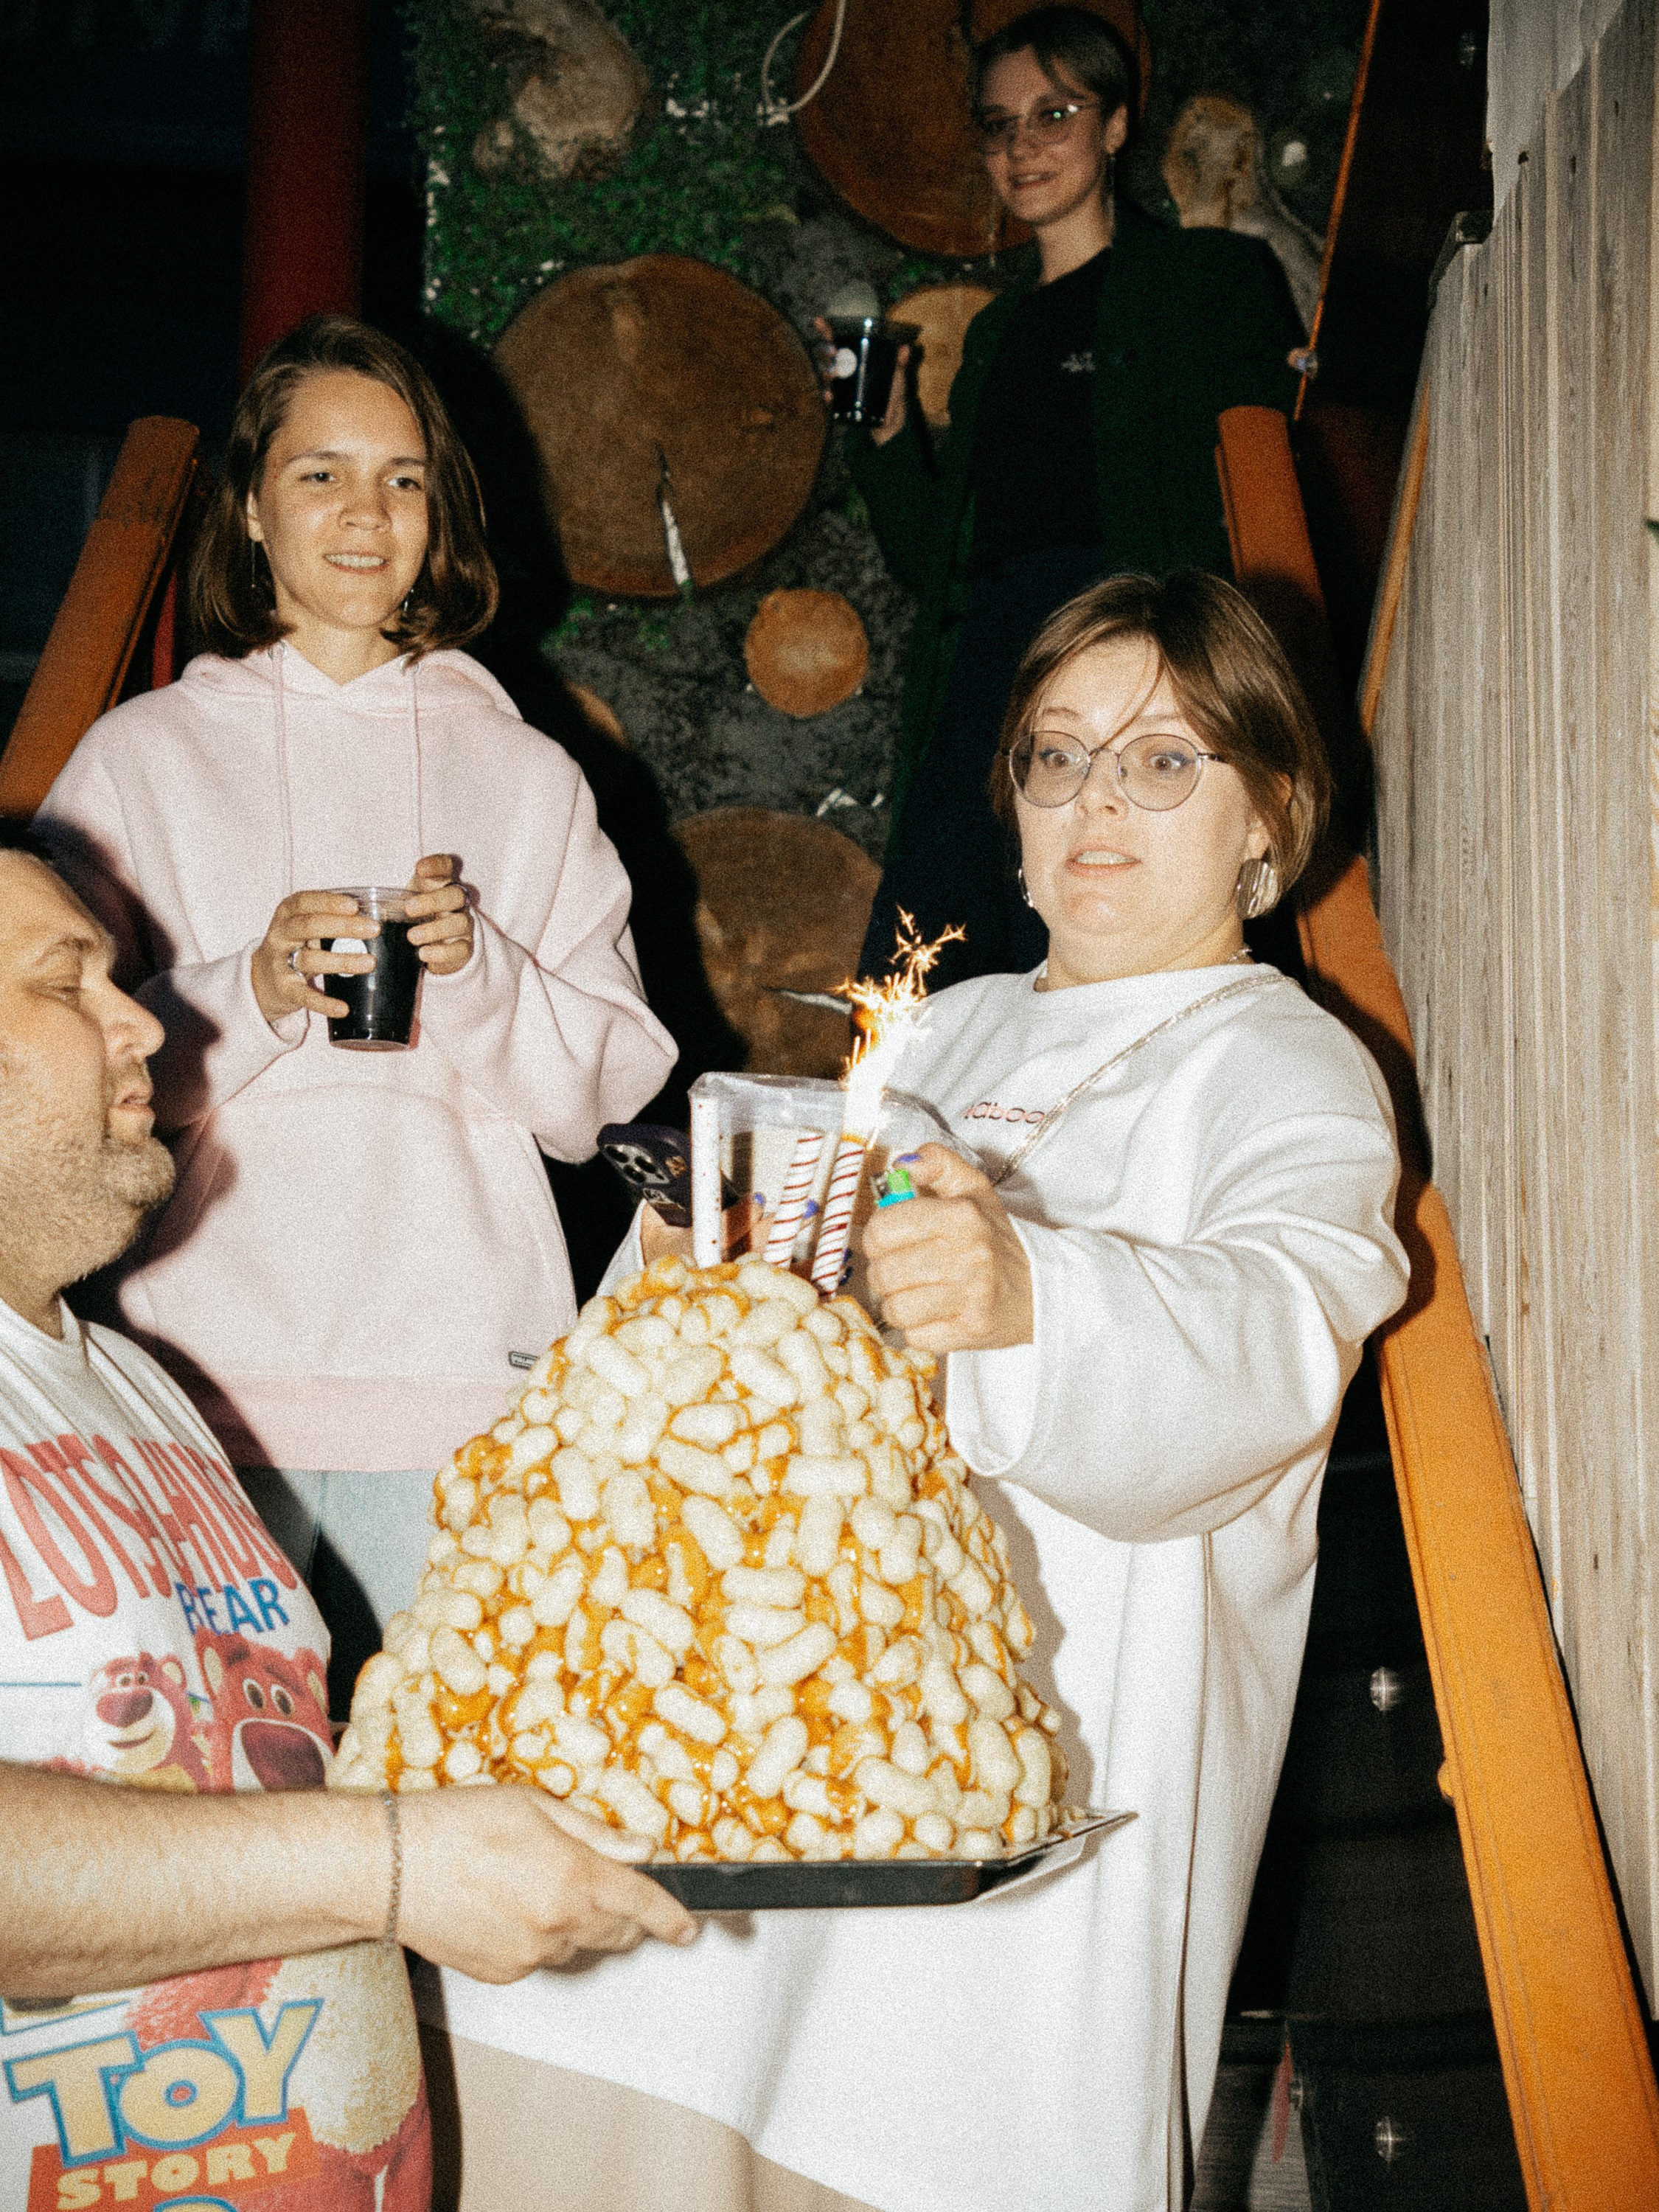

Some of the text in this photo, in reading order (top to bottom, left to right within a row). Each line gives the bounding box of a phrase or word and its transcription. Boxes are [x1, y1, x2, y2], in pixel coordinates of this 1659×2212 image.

[174, 1579, 290, 1635] BEAR
[3, 1998, 324, 2168] TOY
[56, 2132, 296, 2211] STORY
